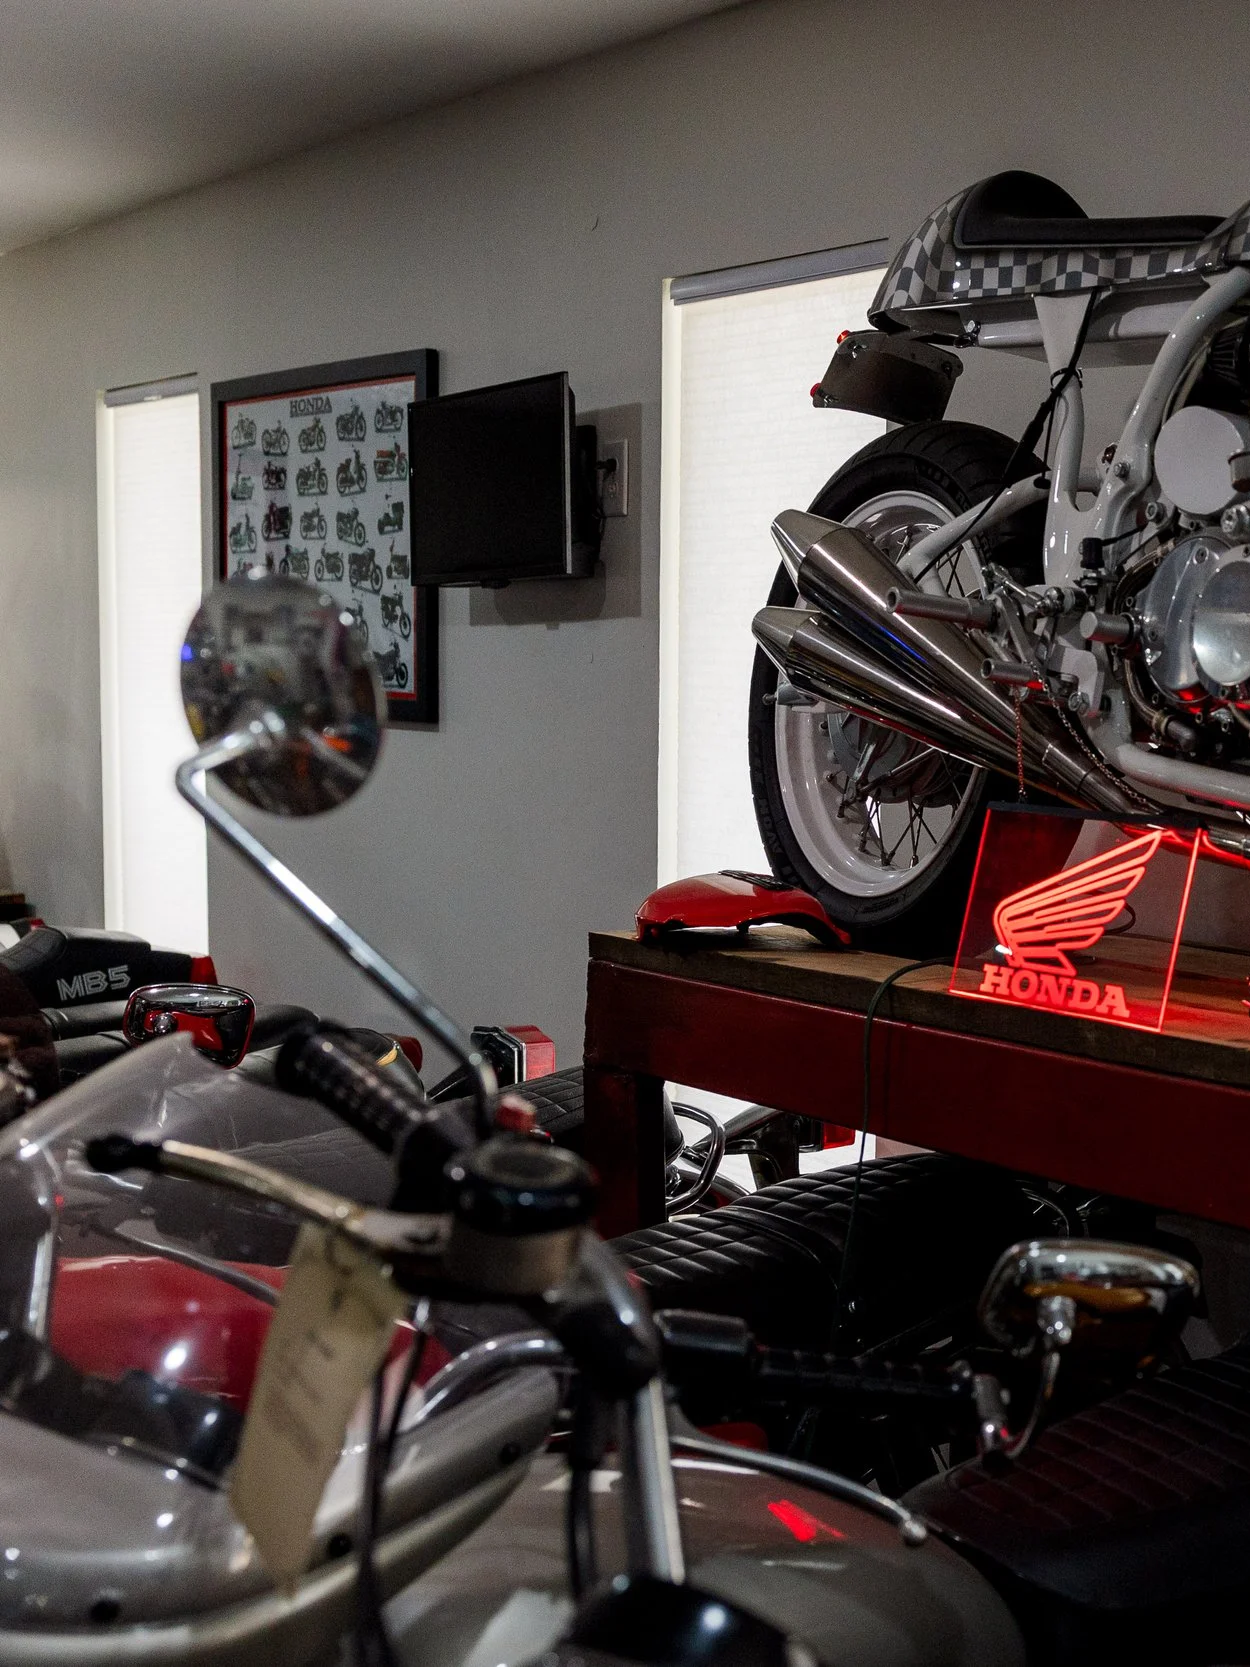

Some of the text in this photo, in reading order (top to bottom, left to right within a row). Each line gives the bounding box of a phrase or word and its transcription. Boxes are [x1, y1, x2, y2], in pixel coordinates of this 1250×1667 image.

[289, 395, 333, 417] HONDA
[55, 964, 132, 1003] MB5
[979, 962, 1131, 1019] HONDA
